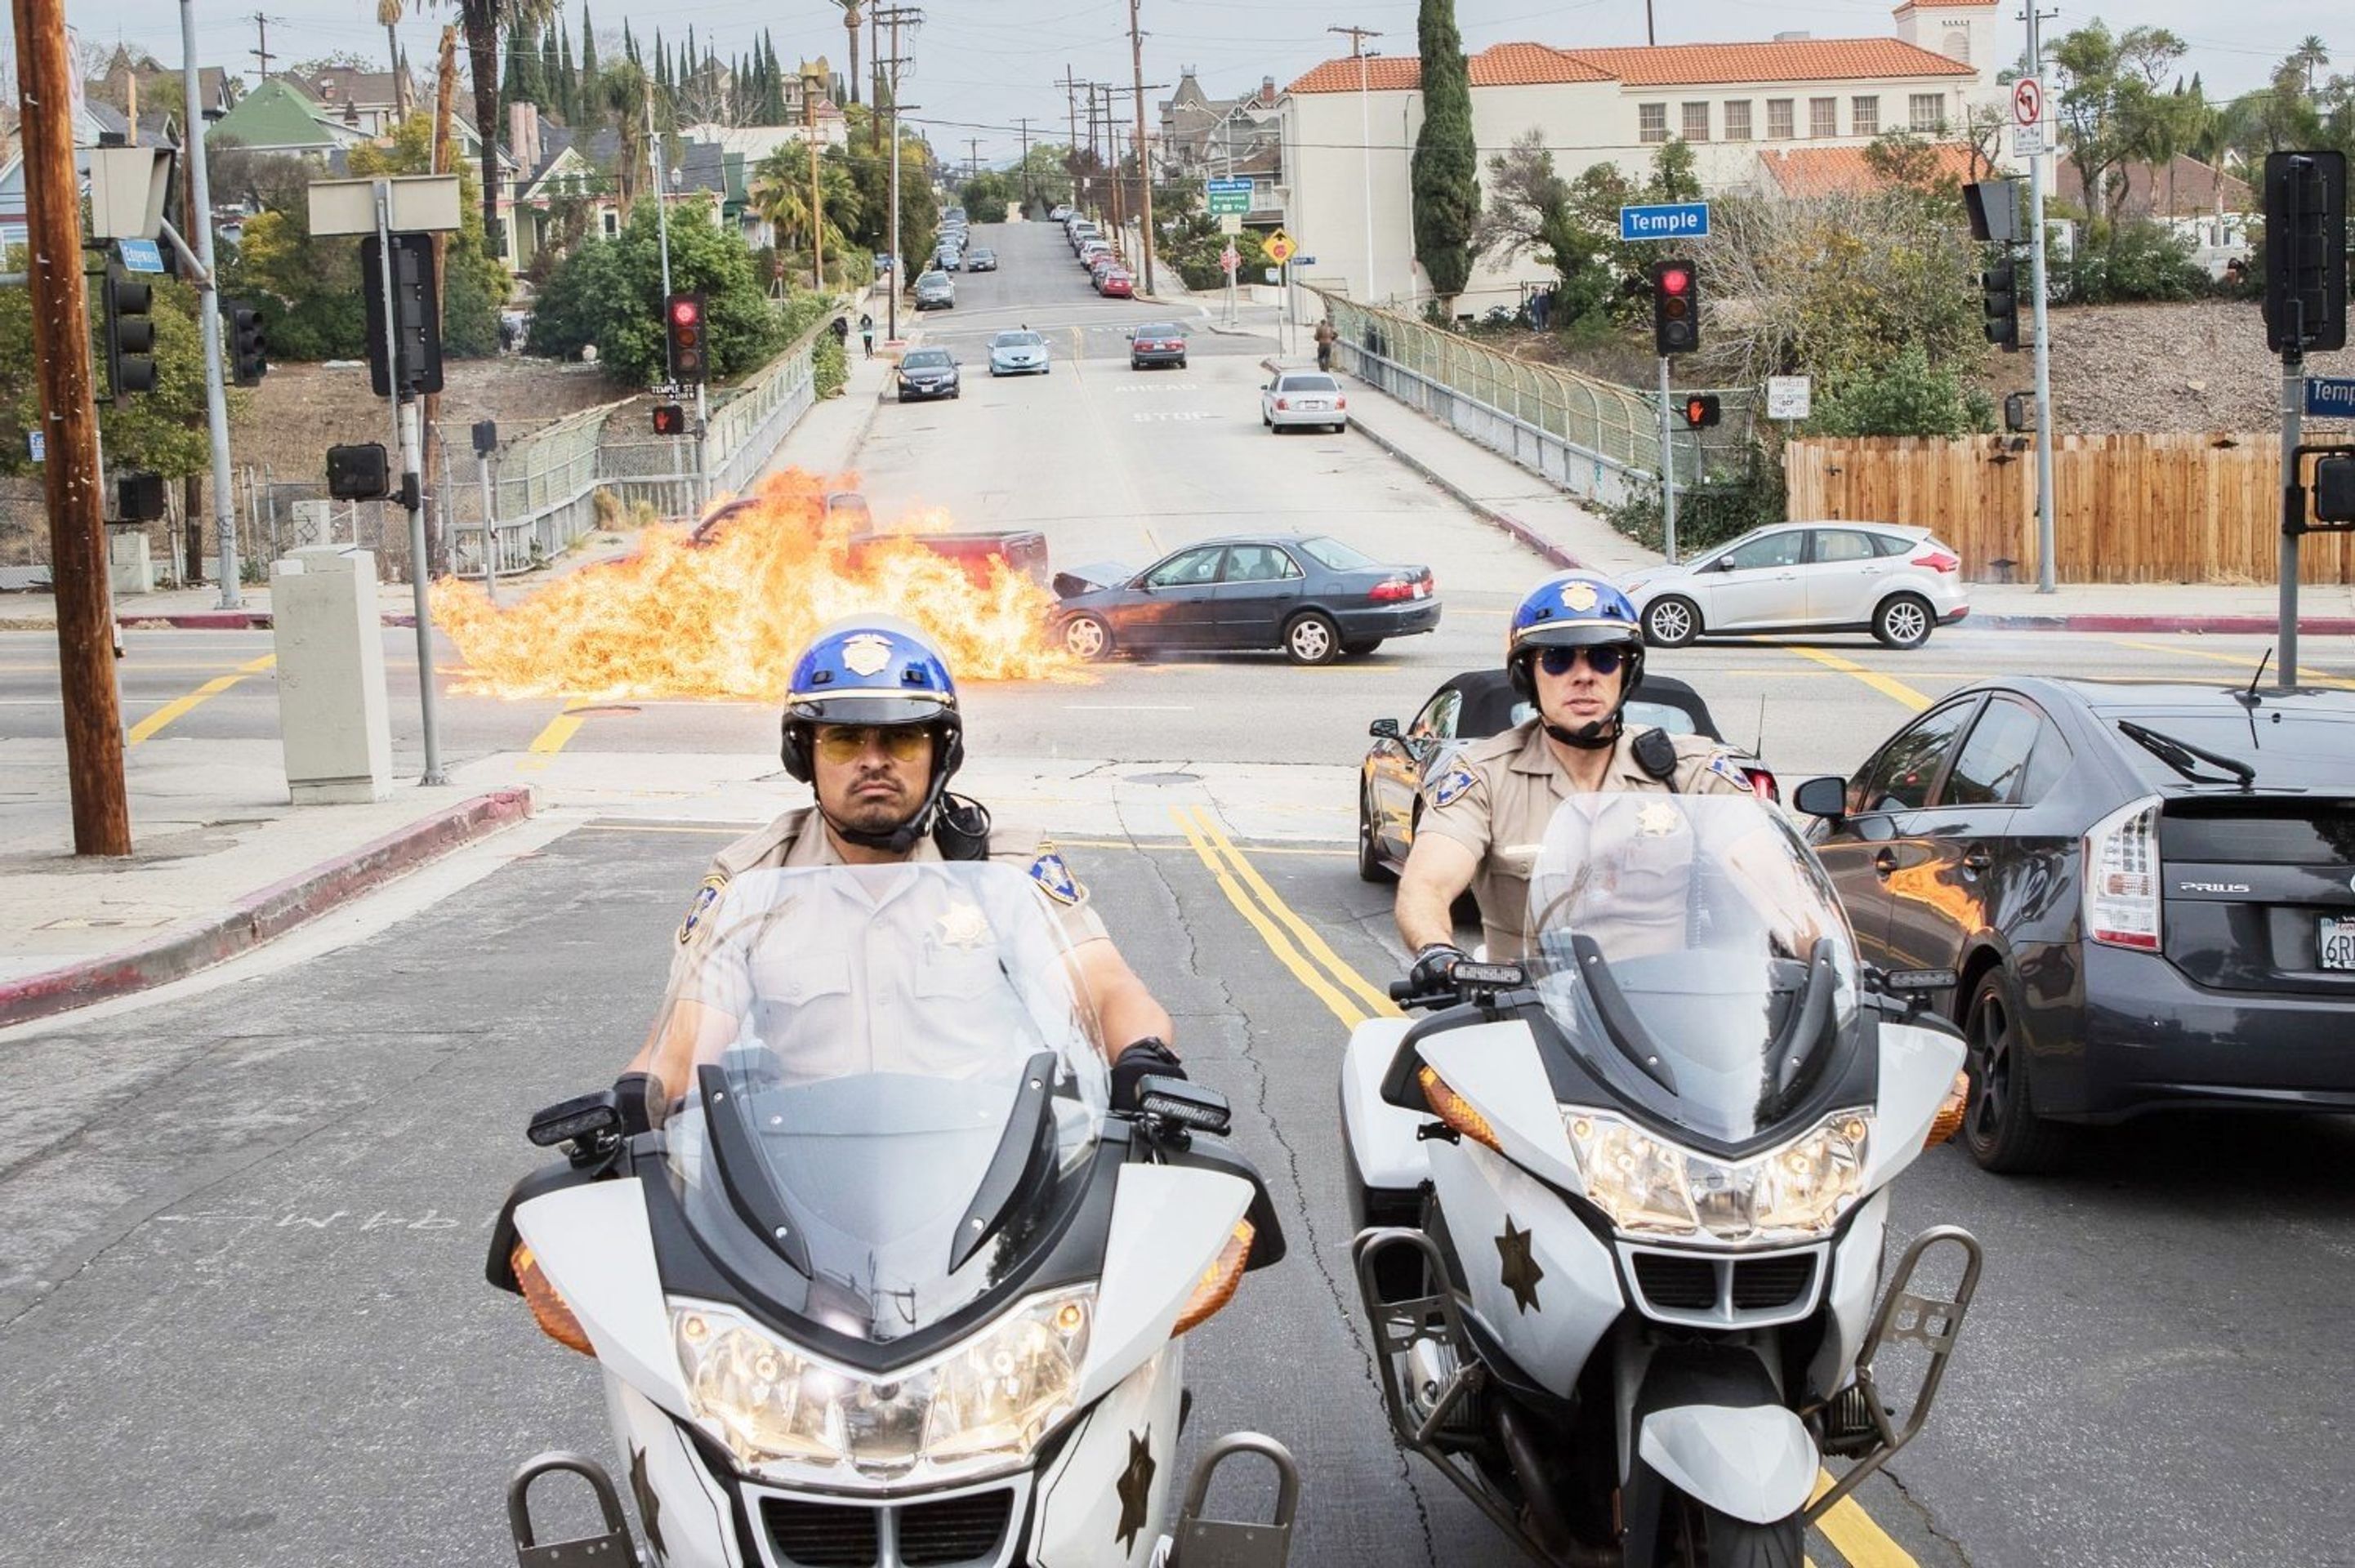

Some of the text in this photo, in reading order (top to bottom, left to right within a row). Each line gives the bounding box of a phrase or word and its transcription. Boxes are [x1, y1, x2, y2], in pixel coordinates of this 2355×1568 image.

[1630, 212, 1698, 232] Temple
[651, 385, 680, 394] TEMPLE
[1115, 384, 1198, 392] AHEAD
[1131, 412, 1210, 422] STOP
[2180, 882, 2250, 893] PRIUS
